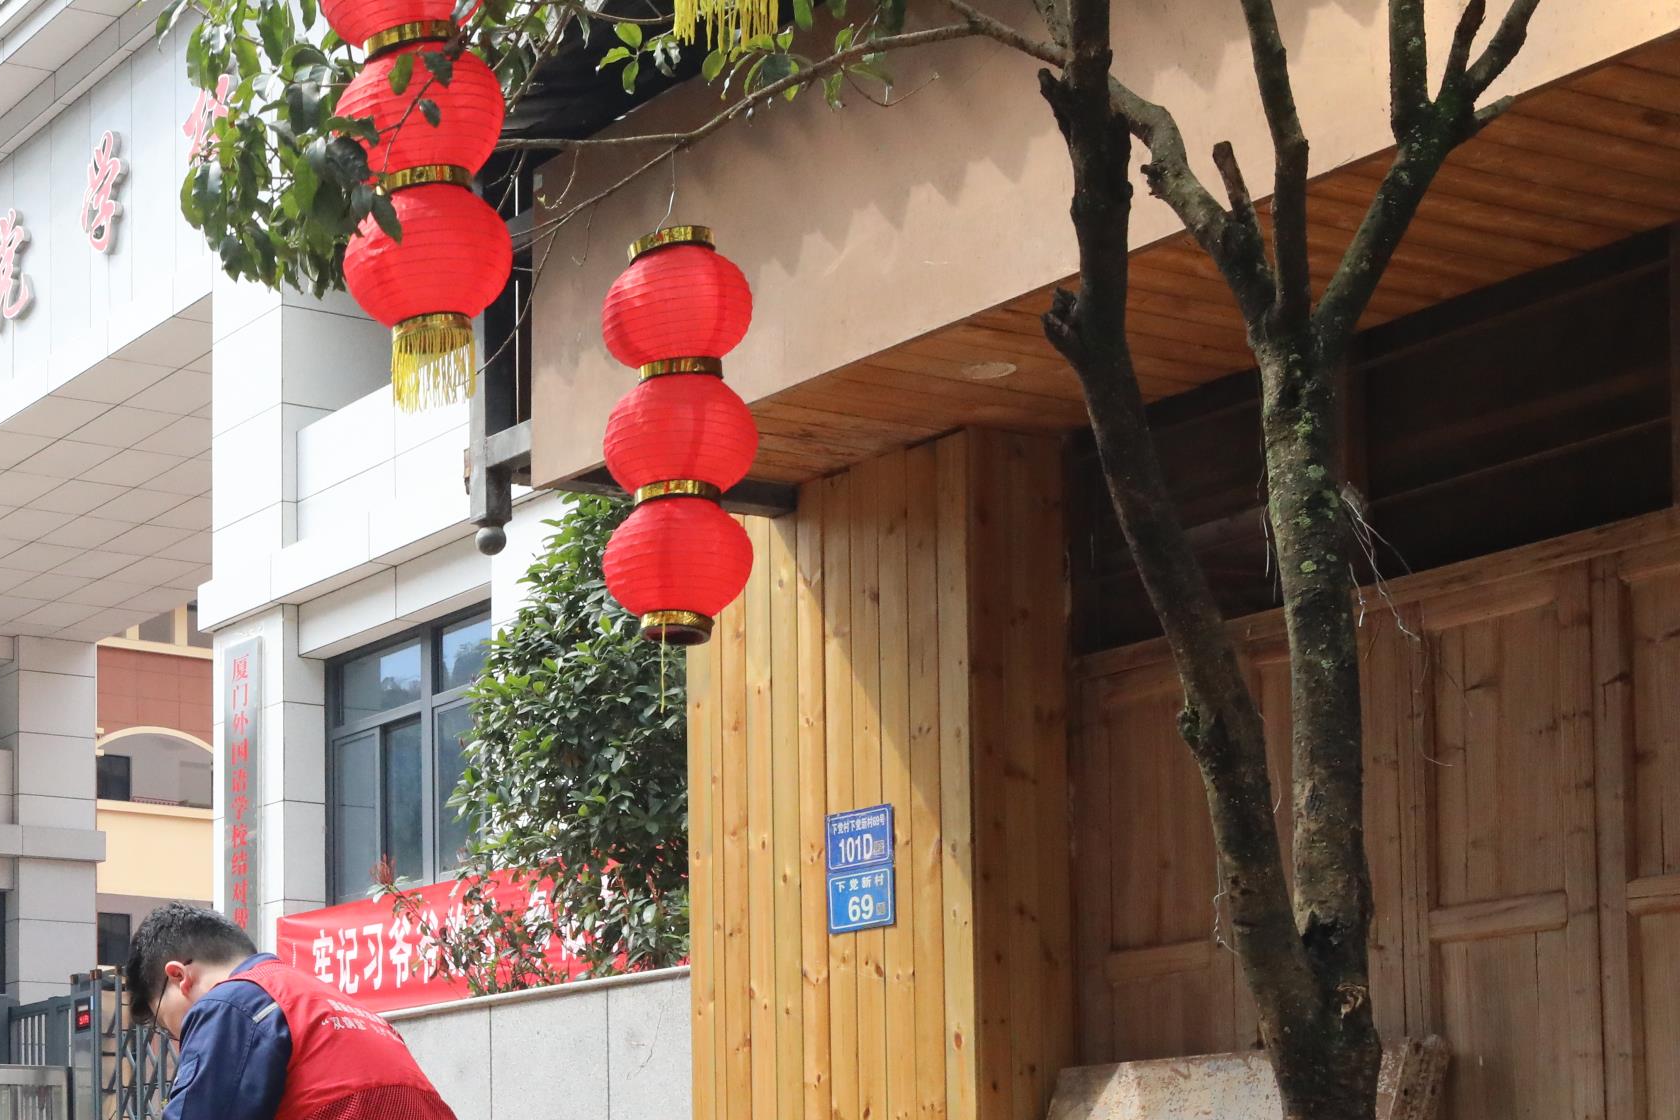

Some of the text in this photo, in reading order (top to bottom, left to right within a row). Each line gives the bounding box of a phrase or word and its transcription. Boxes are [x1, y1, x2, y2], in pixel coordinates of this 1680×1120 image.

[839, 834, 873, 863] 101D
[836, 873, 884, 893] 下党新村
[848, 894, 874, 922] 69
